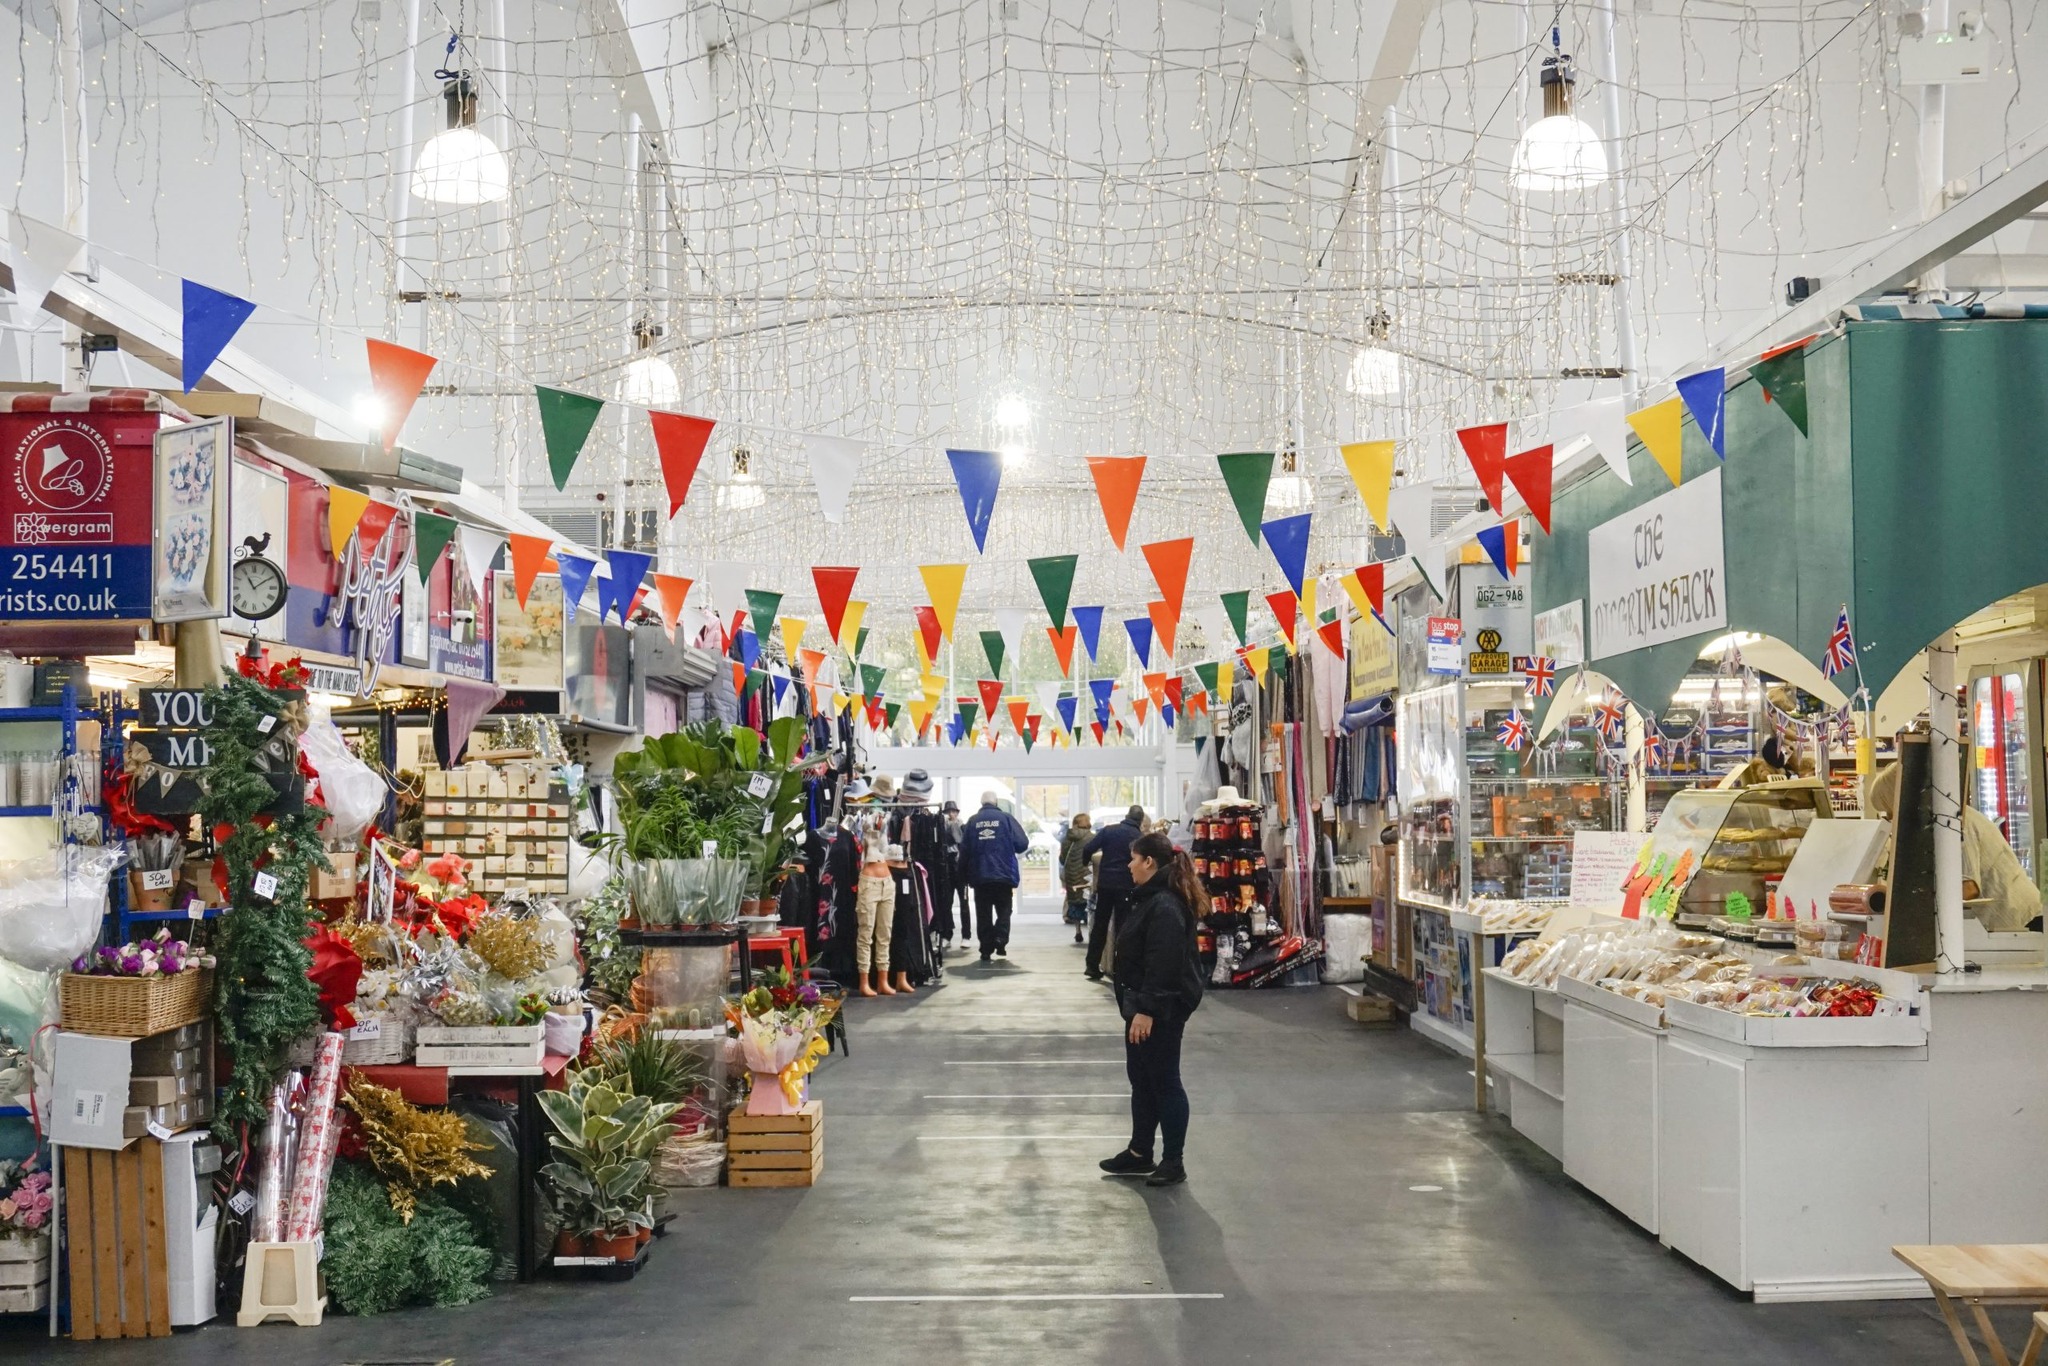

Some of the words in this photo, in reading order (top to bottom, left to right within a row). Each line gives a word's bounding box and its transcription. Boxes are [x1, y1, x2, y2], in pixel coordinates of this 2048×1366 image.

[14, 420, 60, 461] NATIONAL
[77, 421, 114, 503] INTERNATIONAL
[12, 553, 113, 580] 254411
[1431, 619, 1442, 630] bus
[1443, 621, 1459, 634] stop
[1471, 660, 1508, 668] GARAGE
[357, 1024, 379, 1033] EACH
